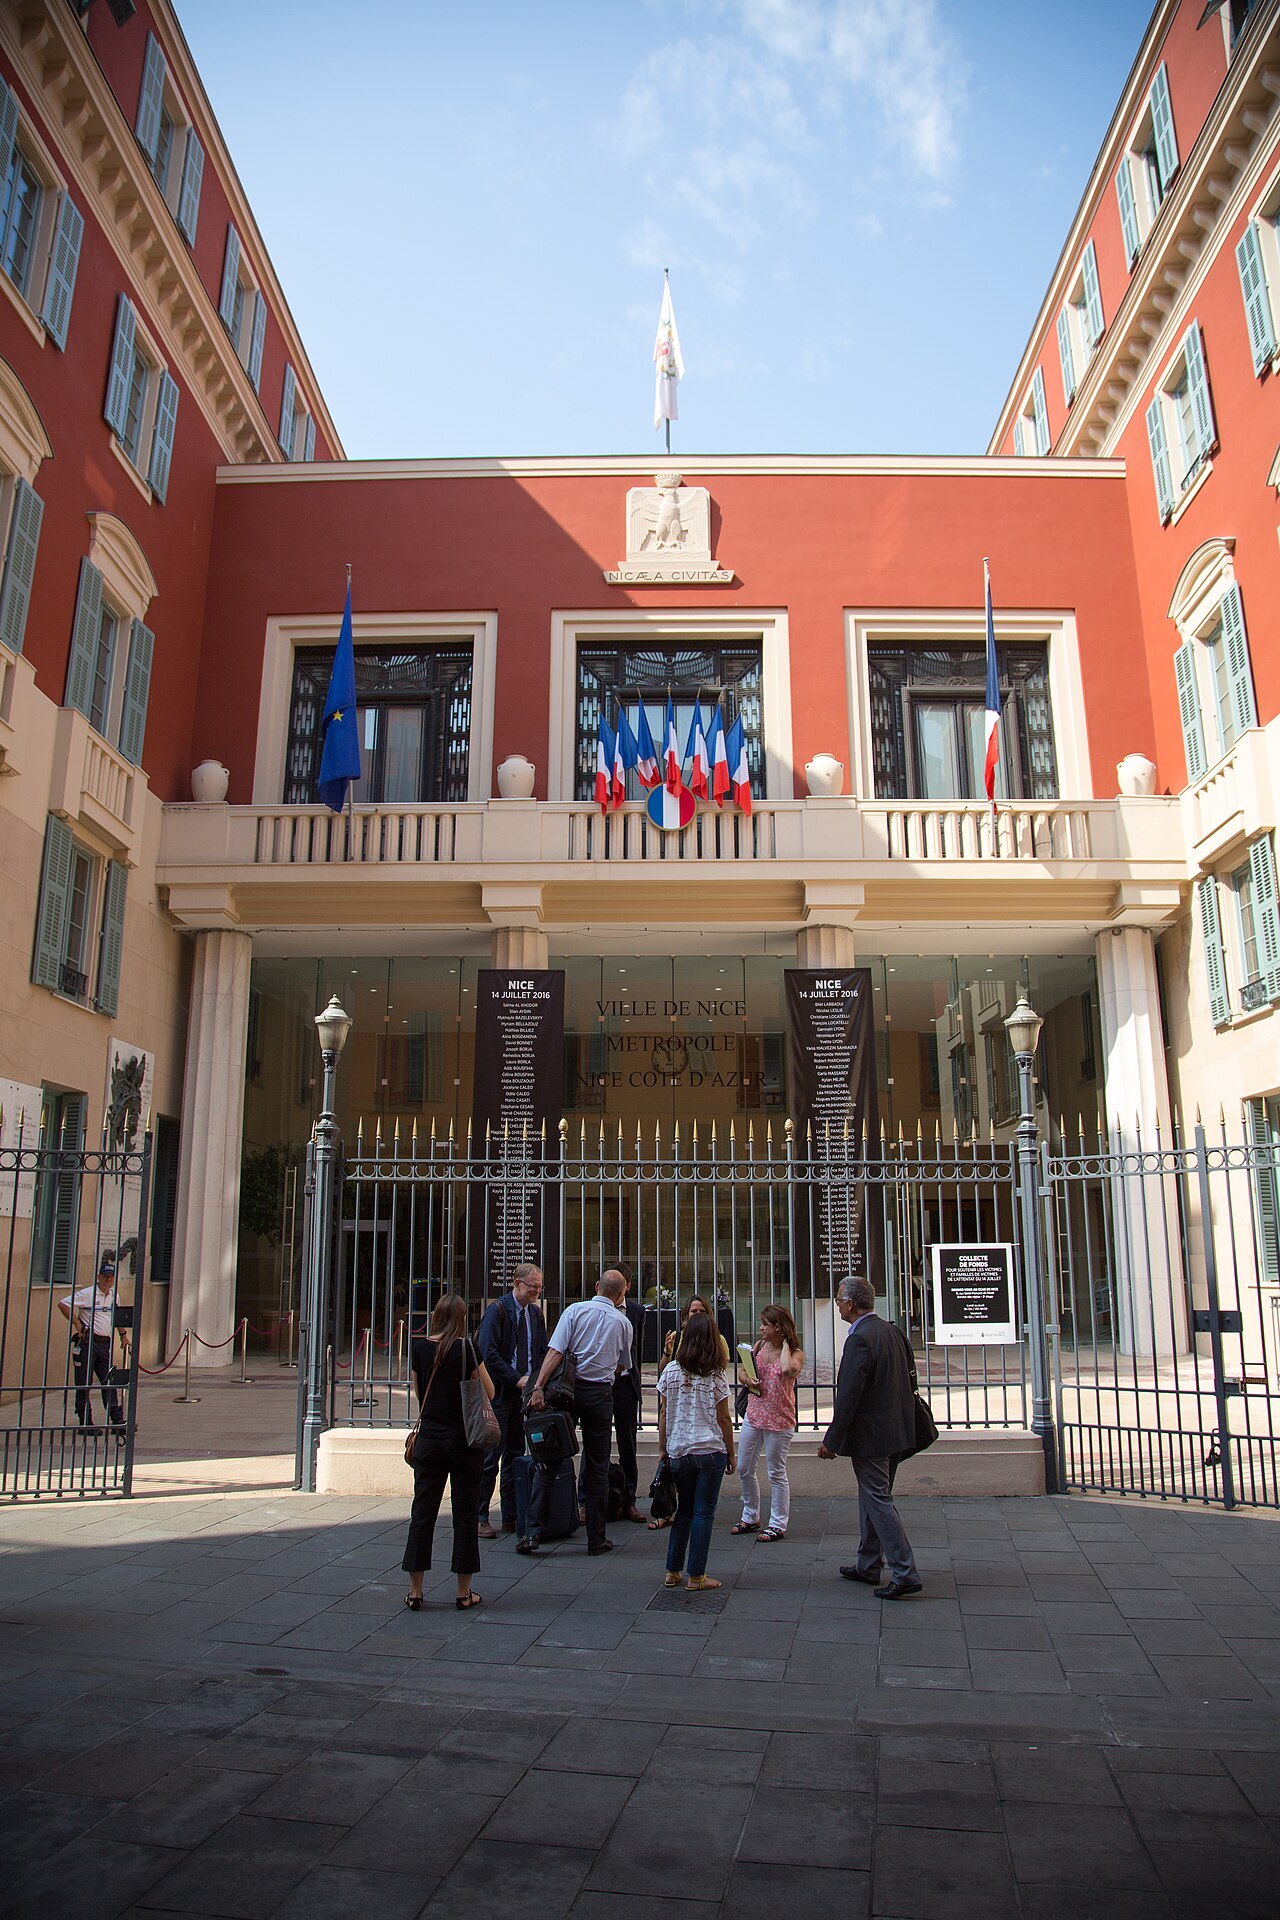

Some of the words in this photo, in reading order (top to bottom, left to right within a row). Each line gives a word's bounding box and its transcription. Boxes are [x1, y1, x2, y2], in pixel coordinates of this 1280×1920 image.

[608, 571, 664, 581] NICÆA
[671, 570, 730, 580] CIVITAS
[508, 980, 535, 990] NICE
[815, 980, 842, 990] NICE
[491, 991, 500, 999] 14
[501, 991, 532, 999] JUILLET
[532, 991, 551, 999] 2016
[840, 990, 859, 998] 2016
[595, 1000, 657, 1017] VILLE
[663, 1000, 691, 1017] DE
[698, 1000, 747, 1017] NICE
[607, 1035, 736, 1052] METROPOLE
[576, 1072, 623, 1088] NICE
